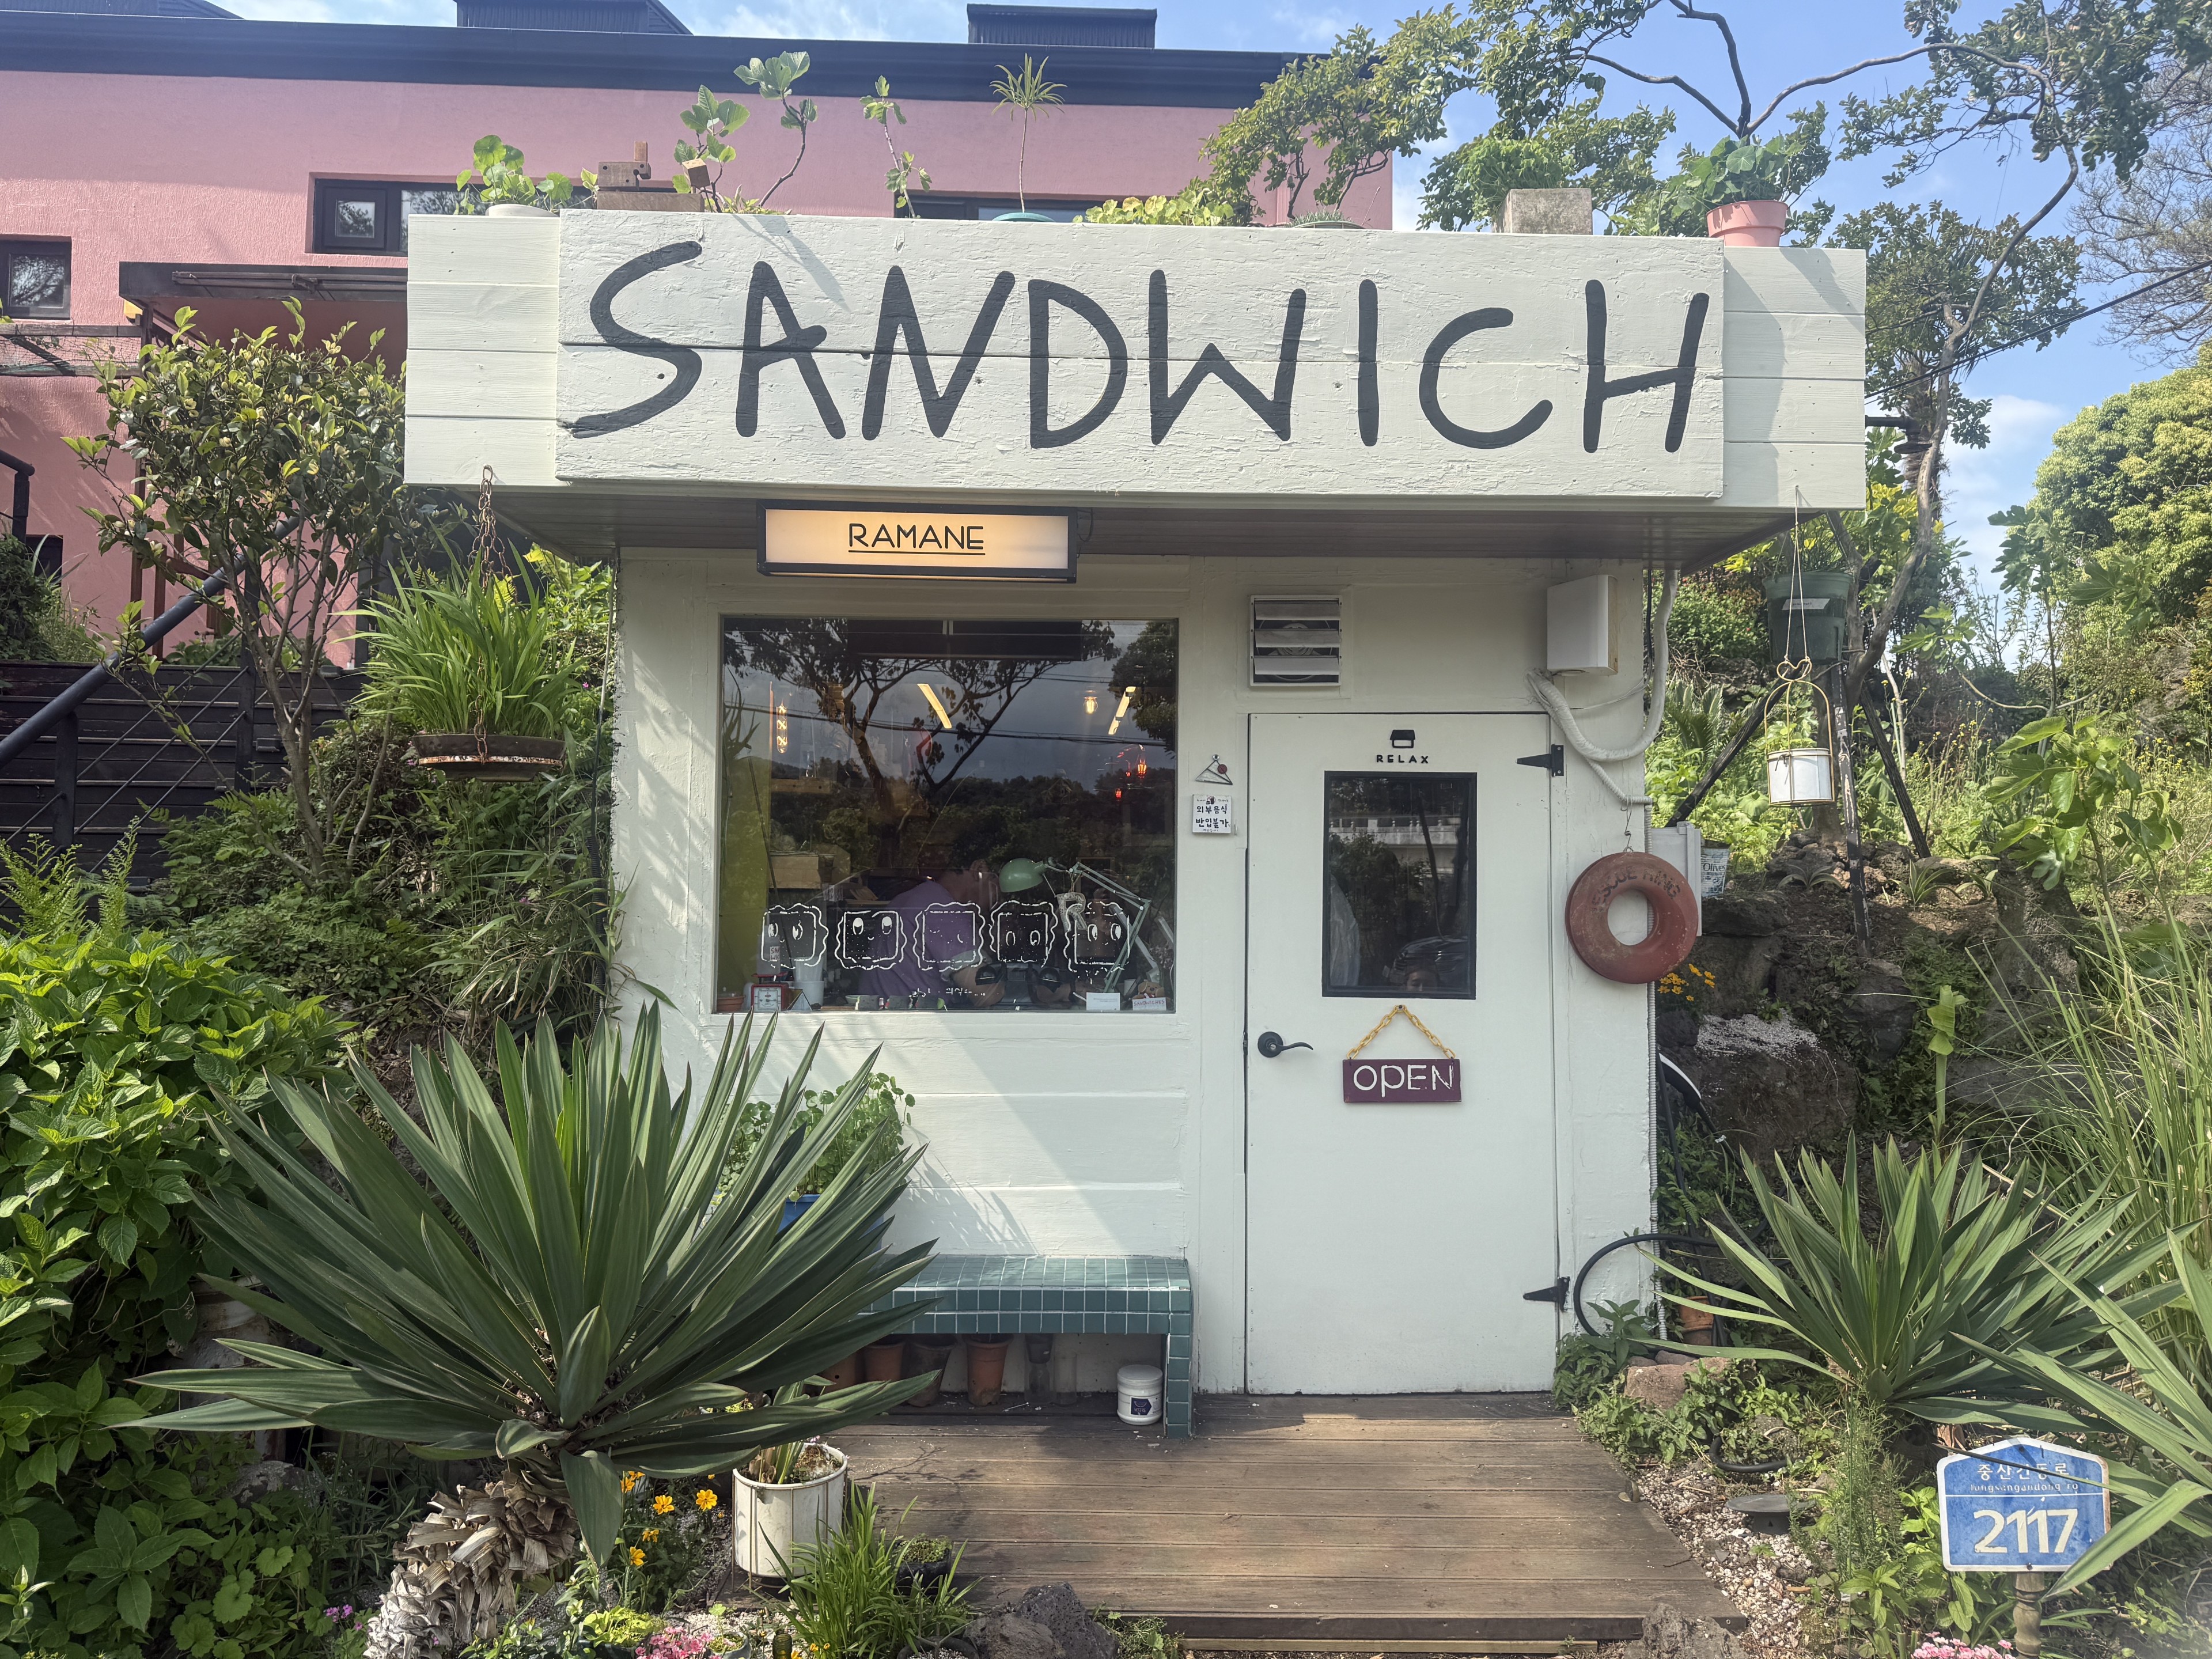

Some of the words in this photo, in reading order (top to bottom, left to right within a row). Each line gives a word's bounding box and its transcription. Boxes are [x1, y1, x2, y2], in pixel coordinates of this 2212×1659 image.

[558, 240, 1710, 454] SANDWICH
[849, 522, 984, 551] RAMANE
[1376, 754, 1429, 764] RELAX
[1196, 805, 1228, 815] 외부음식
[1195, 817, 1229, 829] 반입불가
[1133, 999, 1165, 1007] SANDWICHES
[1353, 1064, 1454, 1098] OPEN
[1974, 1508, 2078, 1554] 2117
